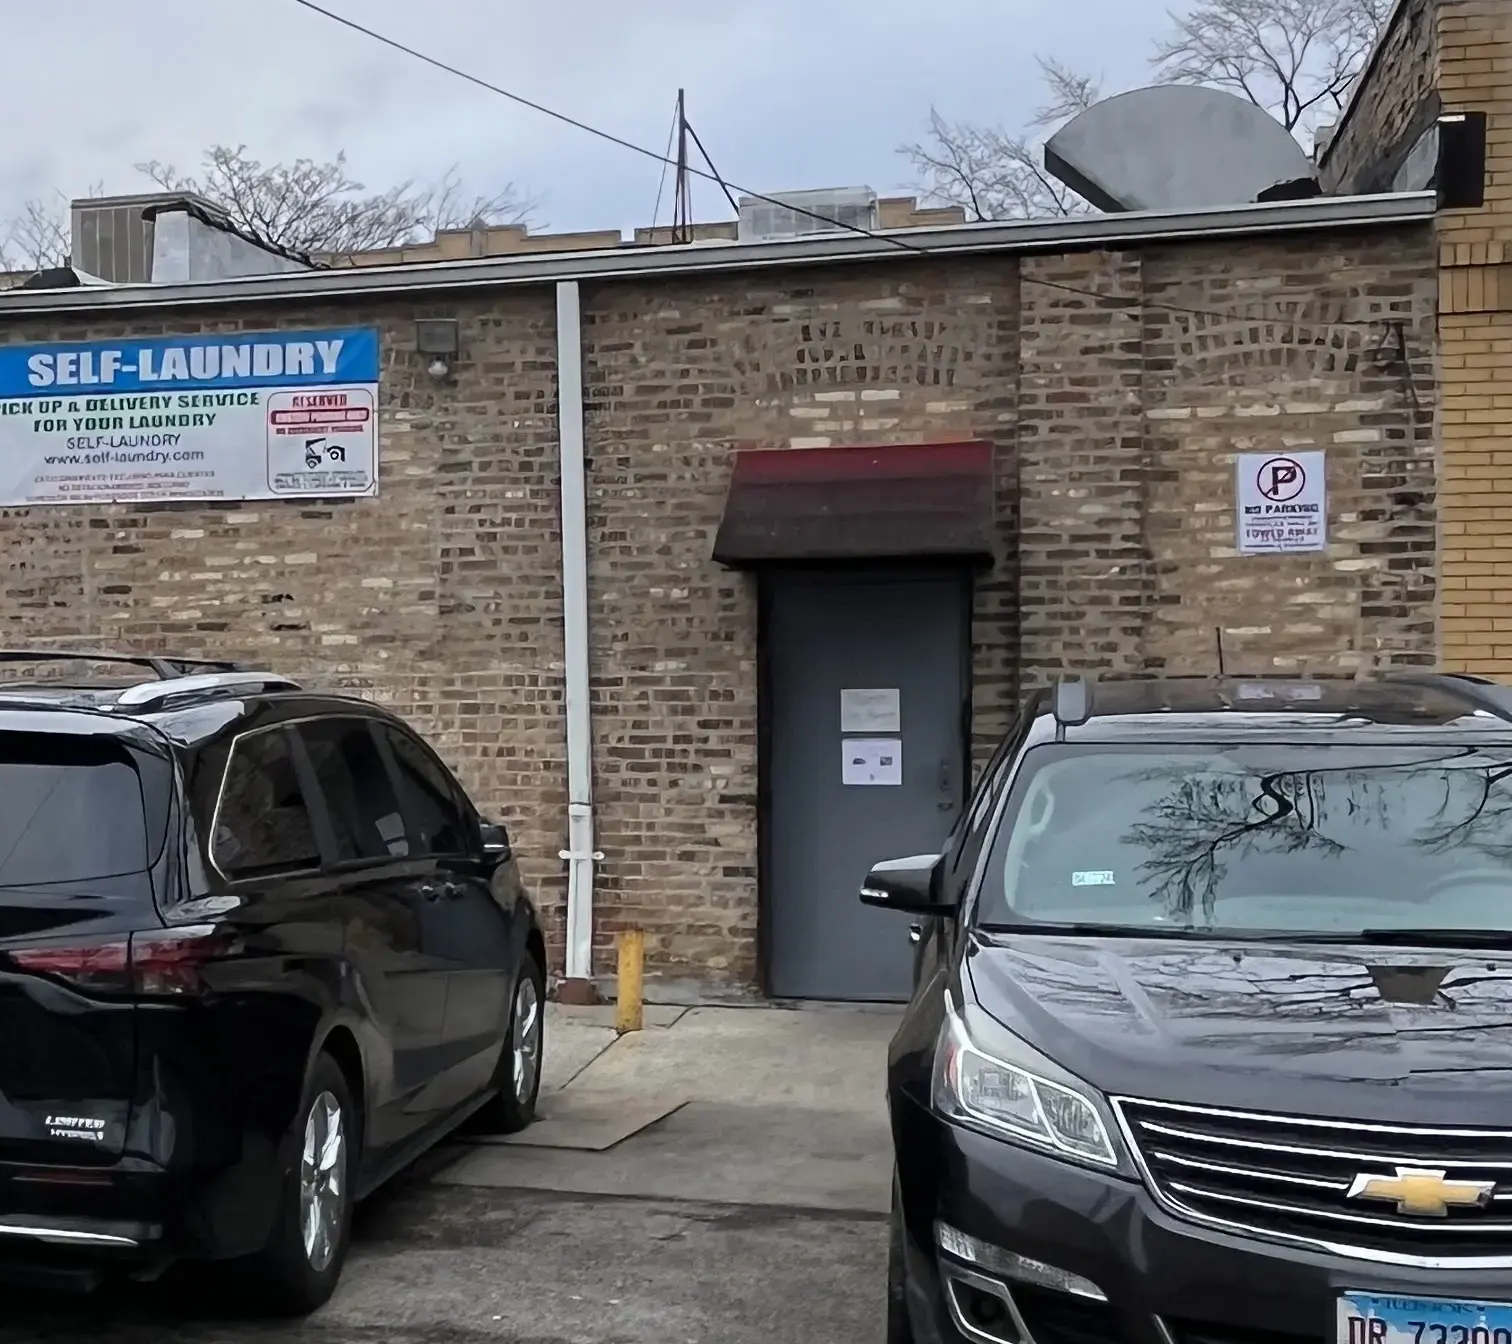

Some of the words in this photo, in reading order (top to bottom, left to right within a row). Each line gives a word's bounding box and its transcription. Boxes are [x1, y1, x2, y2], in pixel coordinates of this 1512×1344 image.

[27, 341, 344, 385] SELF-LAUNDRY
[39, 400, 63, 414] UP
[86, 396, 173, 411] DELIVERY
[178, 392, 260, 408] SERVICE
[75, 417, 124, 431] YOUR
[129, 413, 217, 429] LAUNDRY
[67, 433, 181, 450] SELF-LAUNDRY
